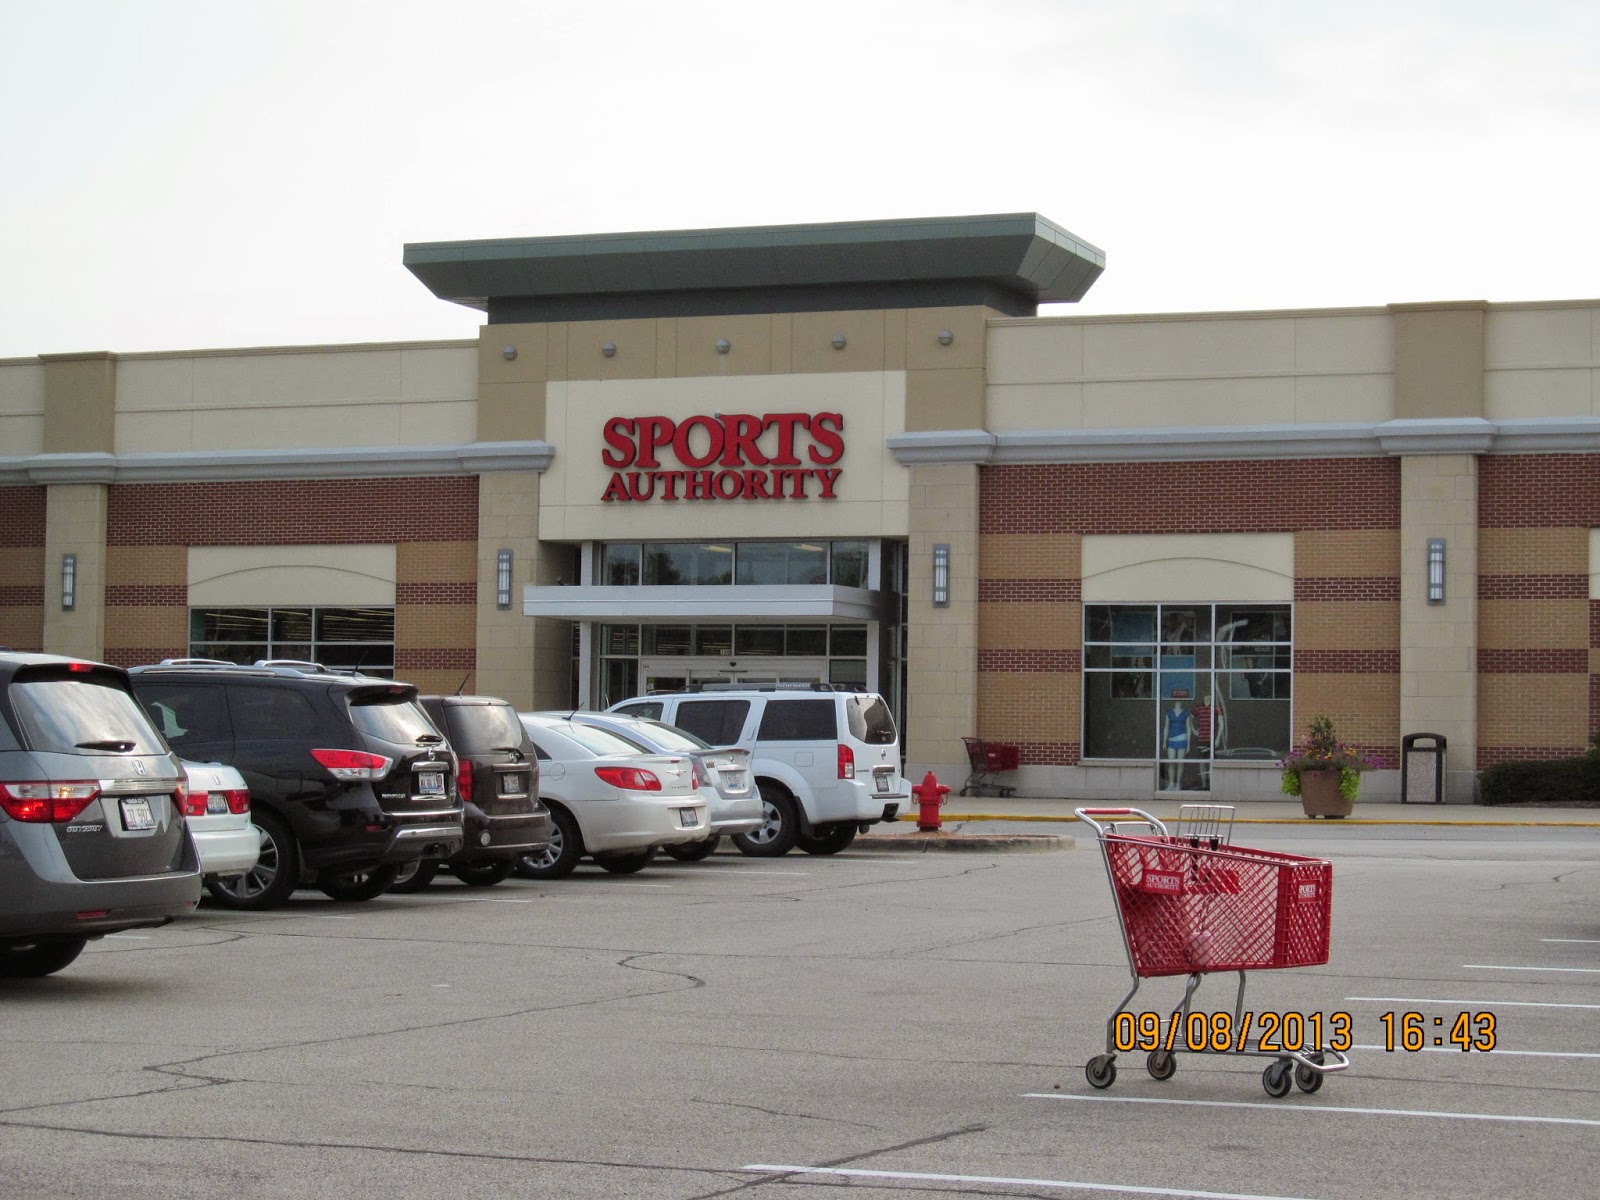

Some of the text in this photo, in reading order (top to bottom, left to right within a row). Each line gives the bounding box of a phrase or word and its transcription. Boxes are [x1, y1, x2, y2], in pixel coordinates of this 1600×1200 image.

[602, 412, 845, 468] SPORTS
[600, 468, 843, 502] AUTHORITY
[66, 824, 103, 833] ODYSSEY
[1146, 874, 1181, 885] SPORTS
